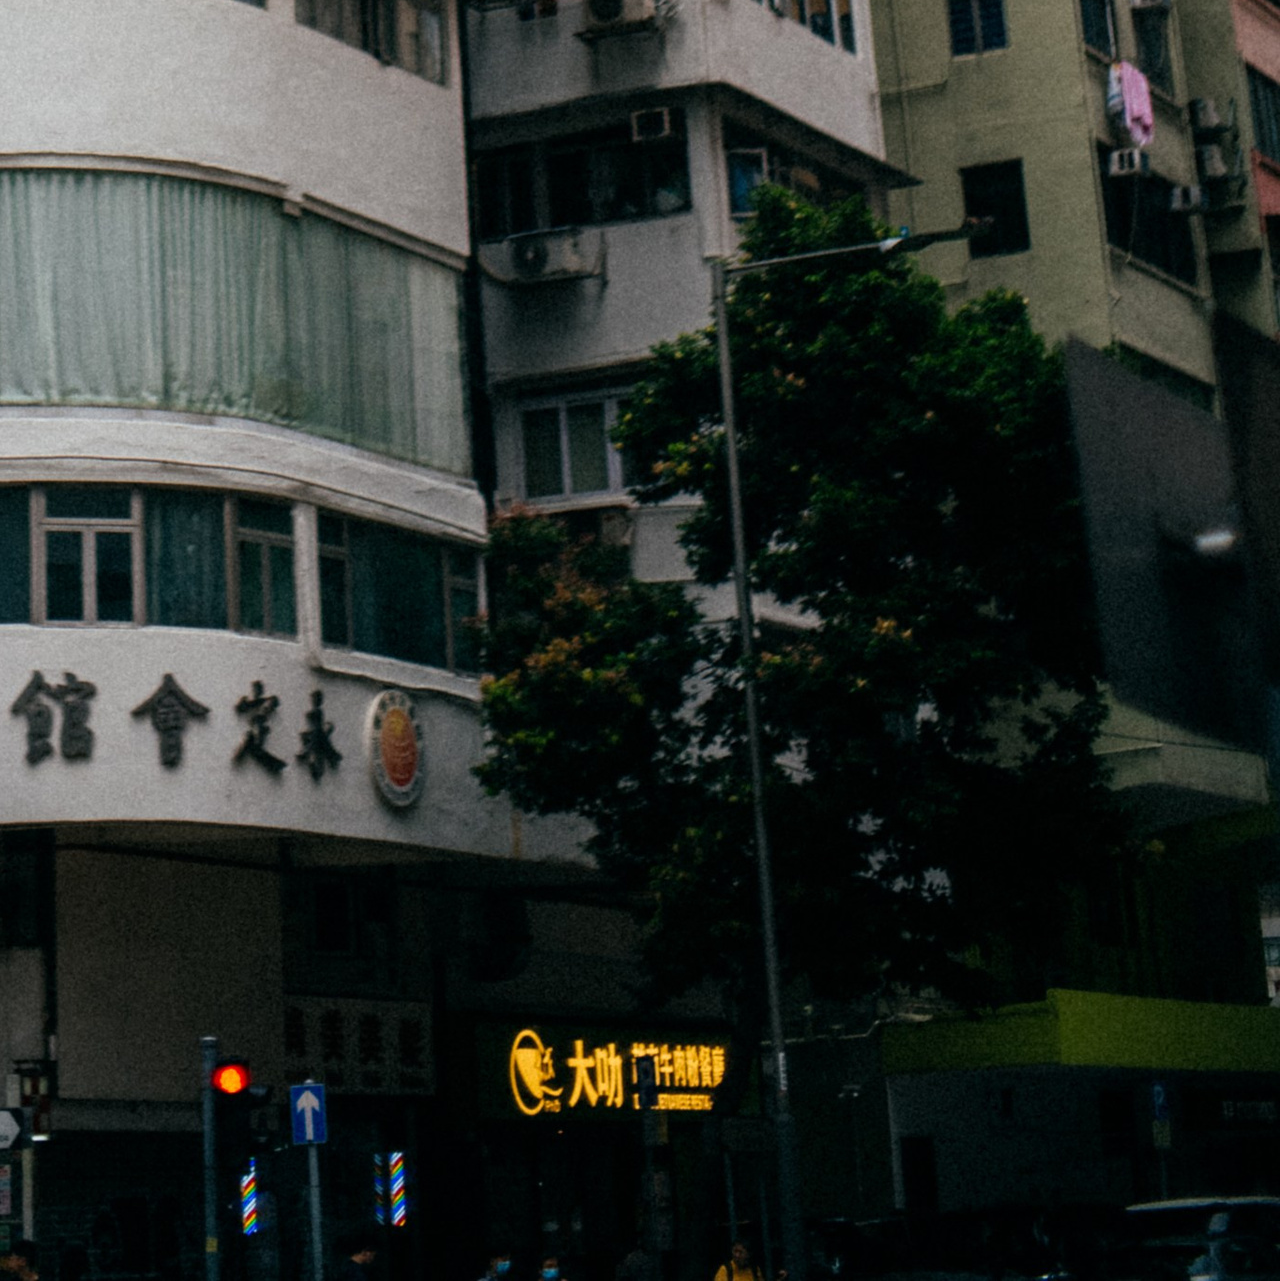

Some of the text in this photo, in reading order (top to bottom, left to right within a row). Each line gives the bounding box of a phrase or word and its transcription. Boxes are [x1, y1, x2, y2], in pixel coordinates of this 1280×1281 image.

[11, 670, 344, 780] 永定會館
[567, 1039, 624, 1108] 大叻
